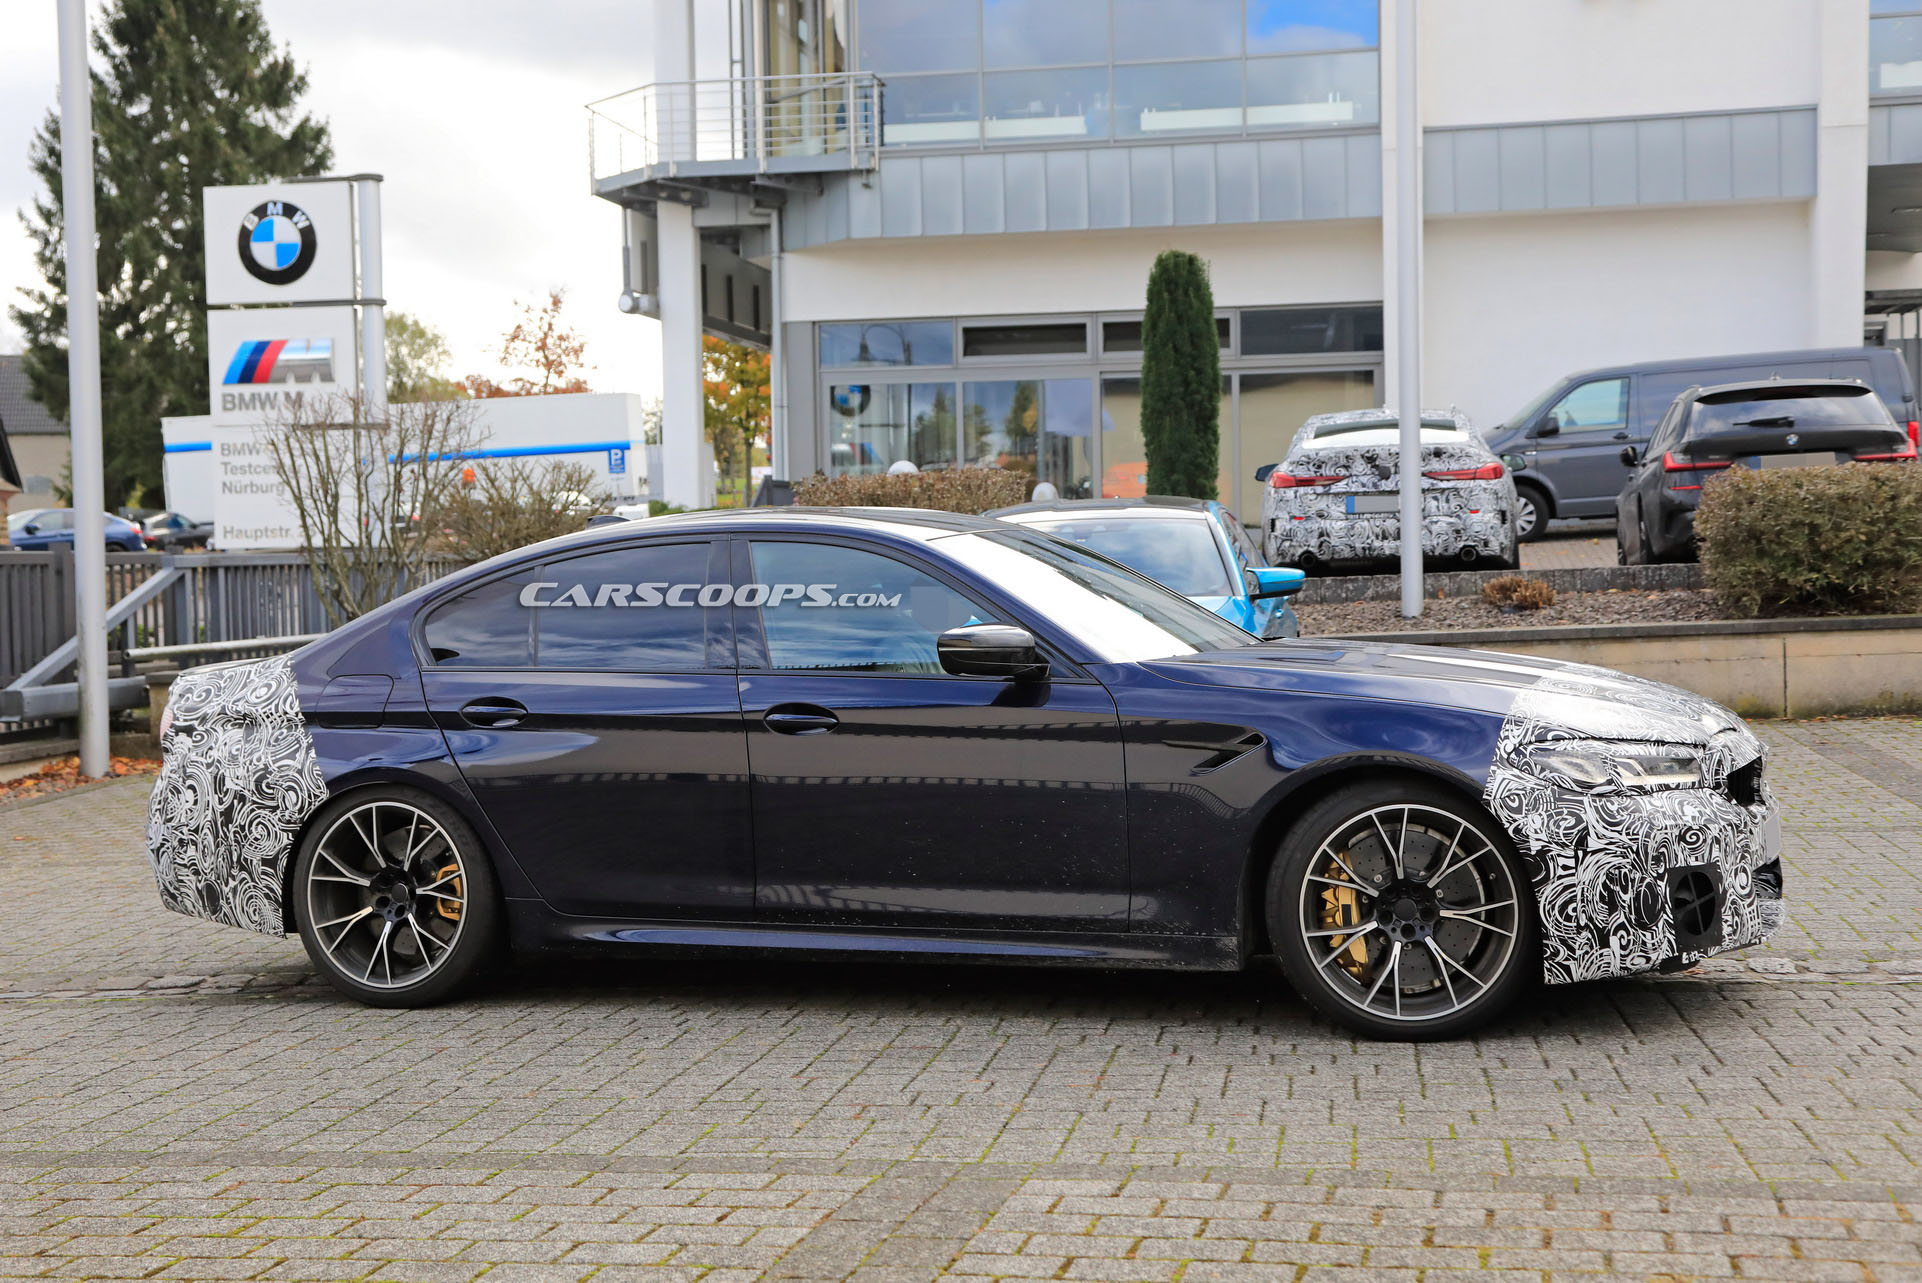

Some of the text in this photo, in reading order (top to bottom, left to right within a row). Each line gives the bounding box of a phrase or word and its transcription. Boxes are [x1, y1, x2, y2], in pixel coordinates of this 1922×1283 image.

[221, 393, 277, 411] BMW
[220, 442, 261, 457] BMW
[611, 449, 622, 465] P
[221, 462, 303, 475] Testce
